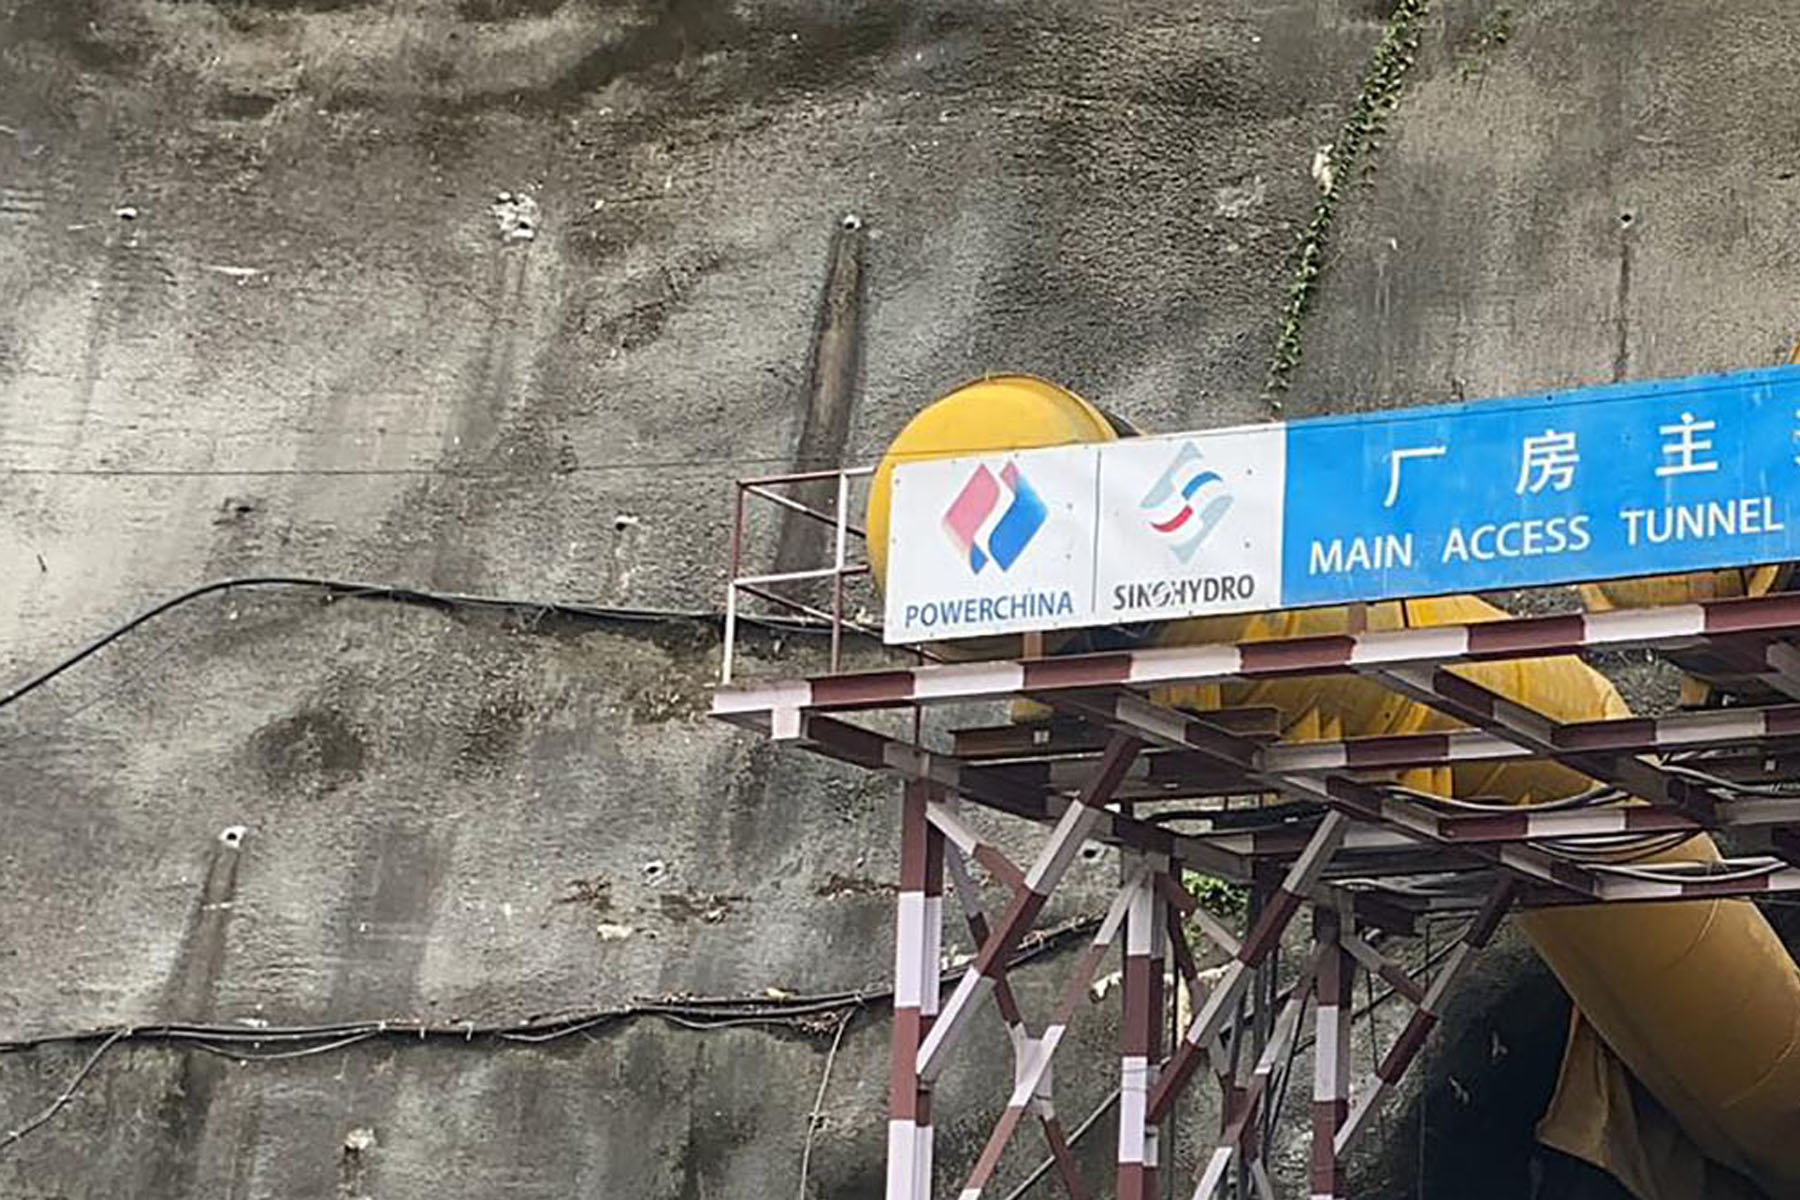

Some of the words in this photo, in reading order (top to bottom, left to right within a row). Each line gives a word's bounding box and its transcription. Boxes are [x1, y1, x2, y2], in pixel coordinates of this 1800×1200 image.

[1308, 533, 1413, 575] MAIN
[1441, 515, 1591, 563] ACCESS
[1619, 496, 1785, 546] TUNNEL
[905, 591, 1074, 628] POWERCHINA
[1113, 574, 1255, 611] SINOHYDRO
